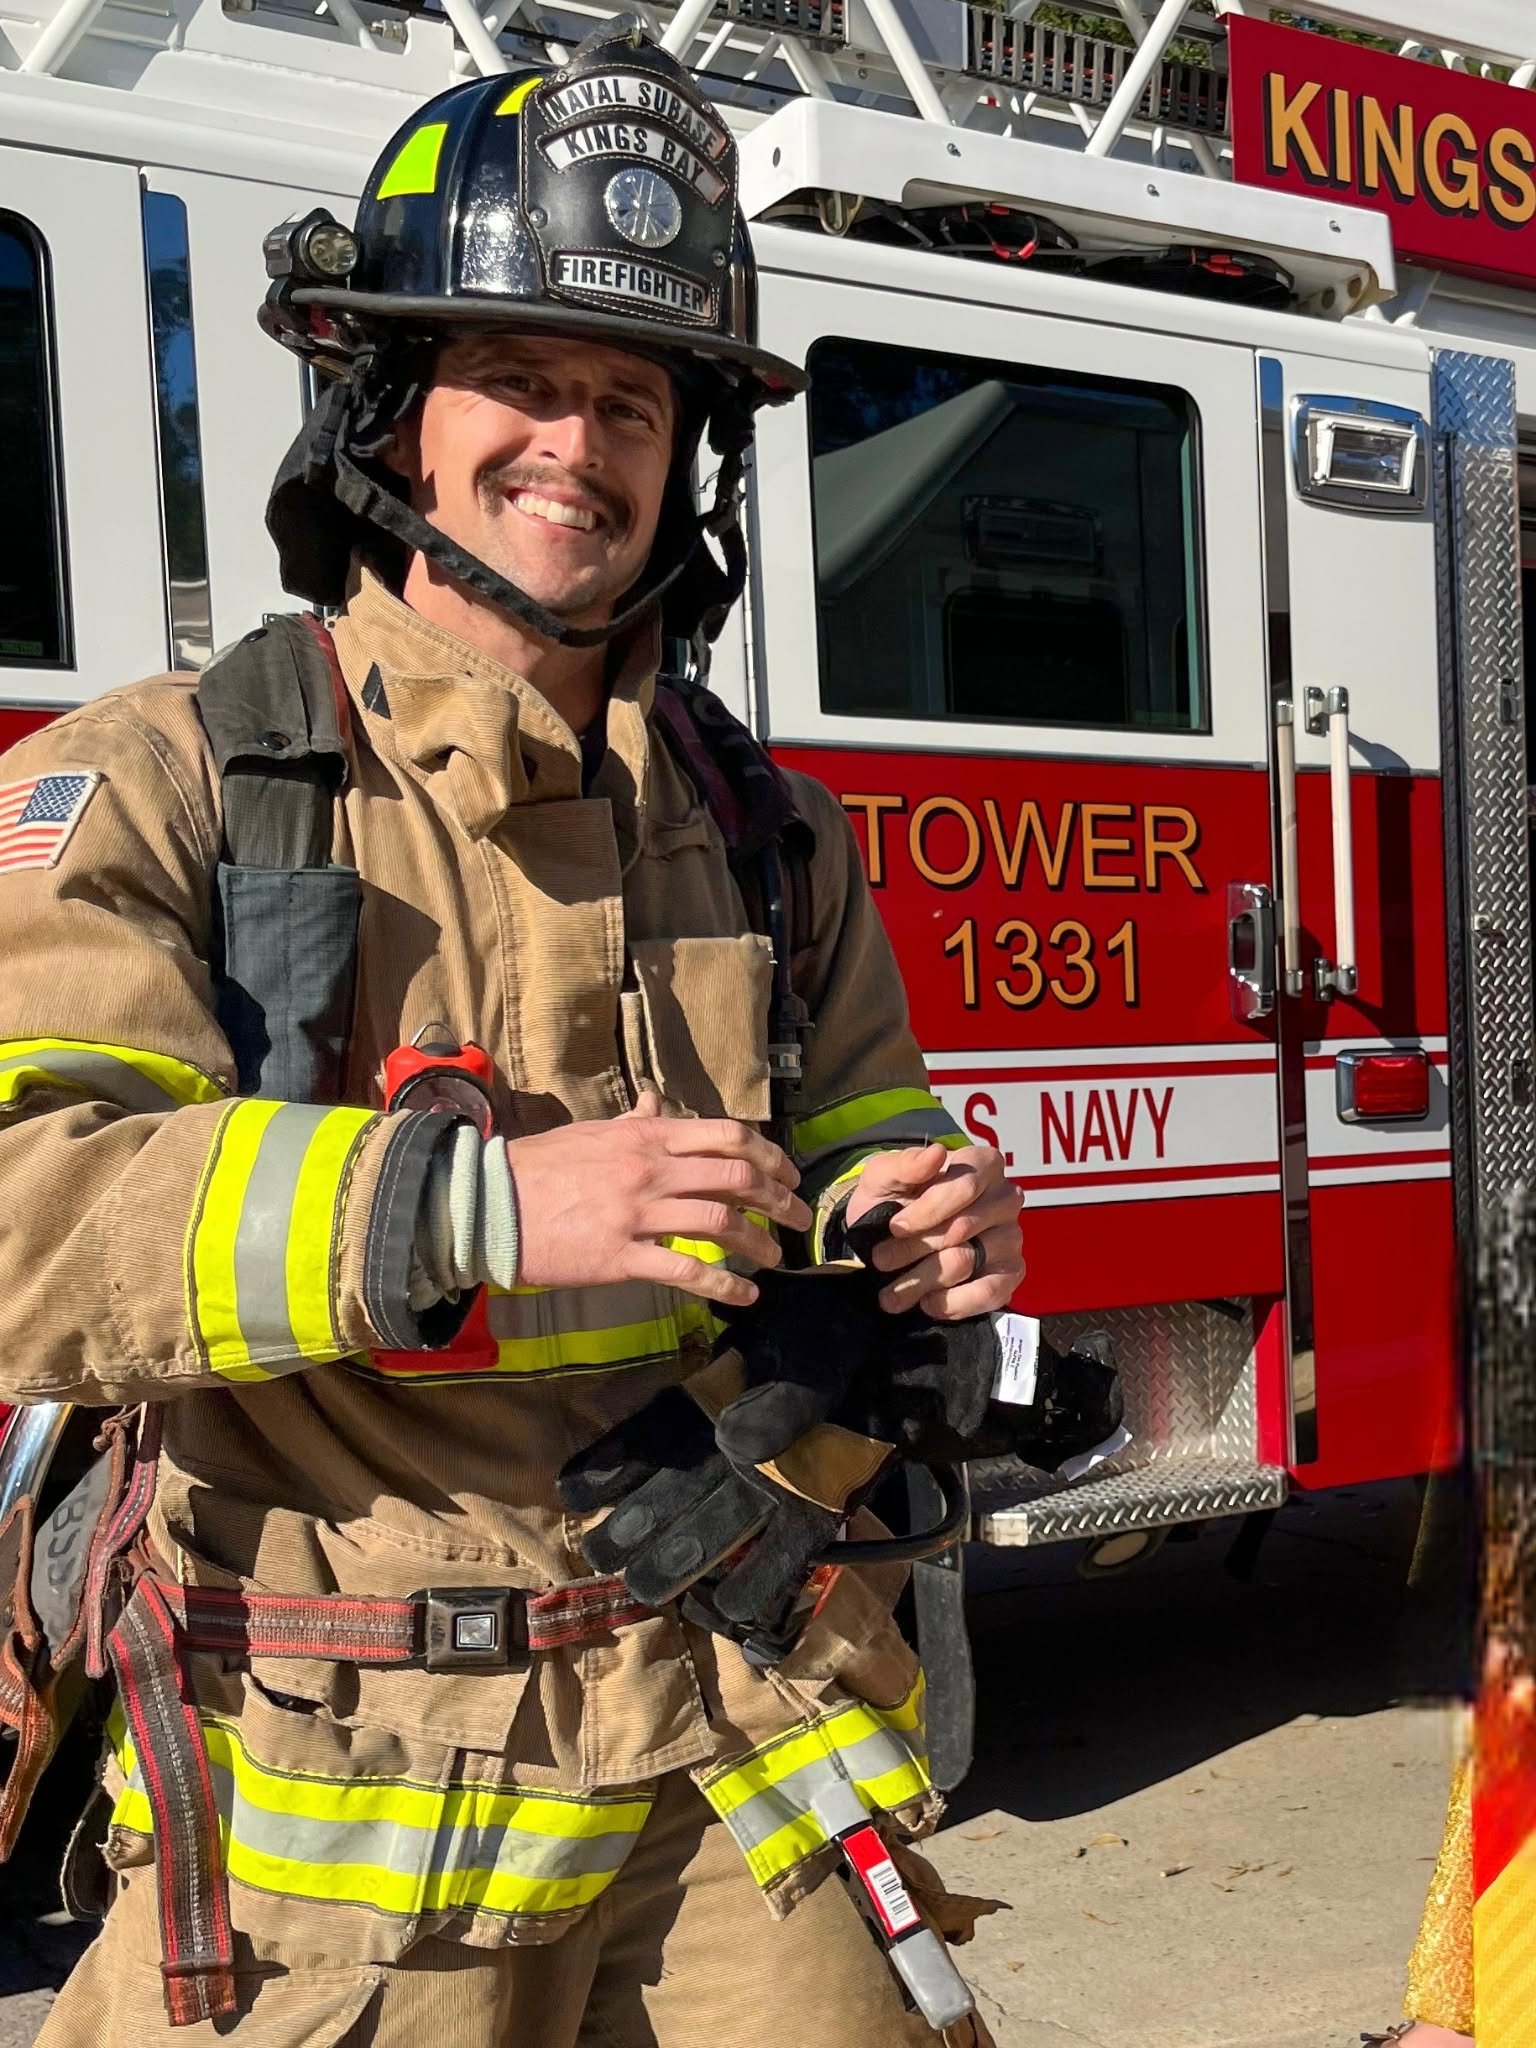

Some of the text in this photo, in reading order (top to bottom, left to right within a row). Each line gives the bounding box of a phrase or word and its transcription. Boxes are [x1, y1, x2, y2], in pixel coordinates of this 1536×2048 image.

[546, 78, 719, 151] NAVAL SUBASE
[1264, 72, 1536, 229] KINGS
[564, 124, 706, 186] KINGS BAY
[557, 257, 705, 314] FIREFIGHTER
[840, 794, 1207, 891] TOWER
[943, 919, 1140, 1010] 1331
[1039, 1086, 1175, 1165] NAVY
